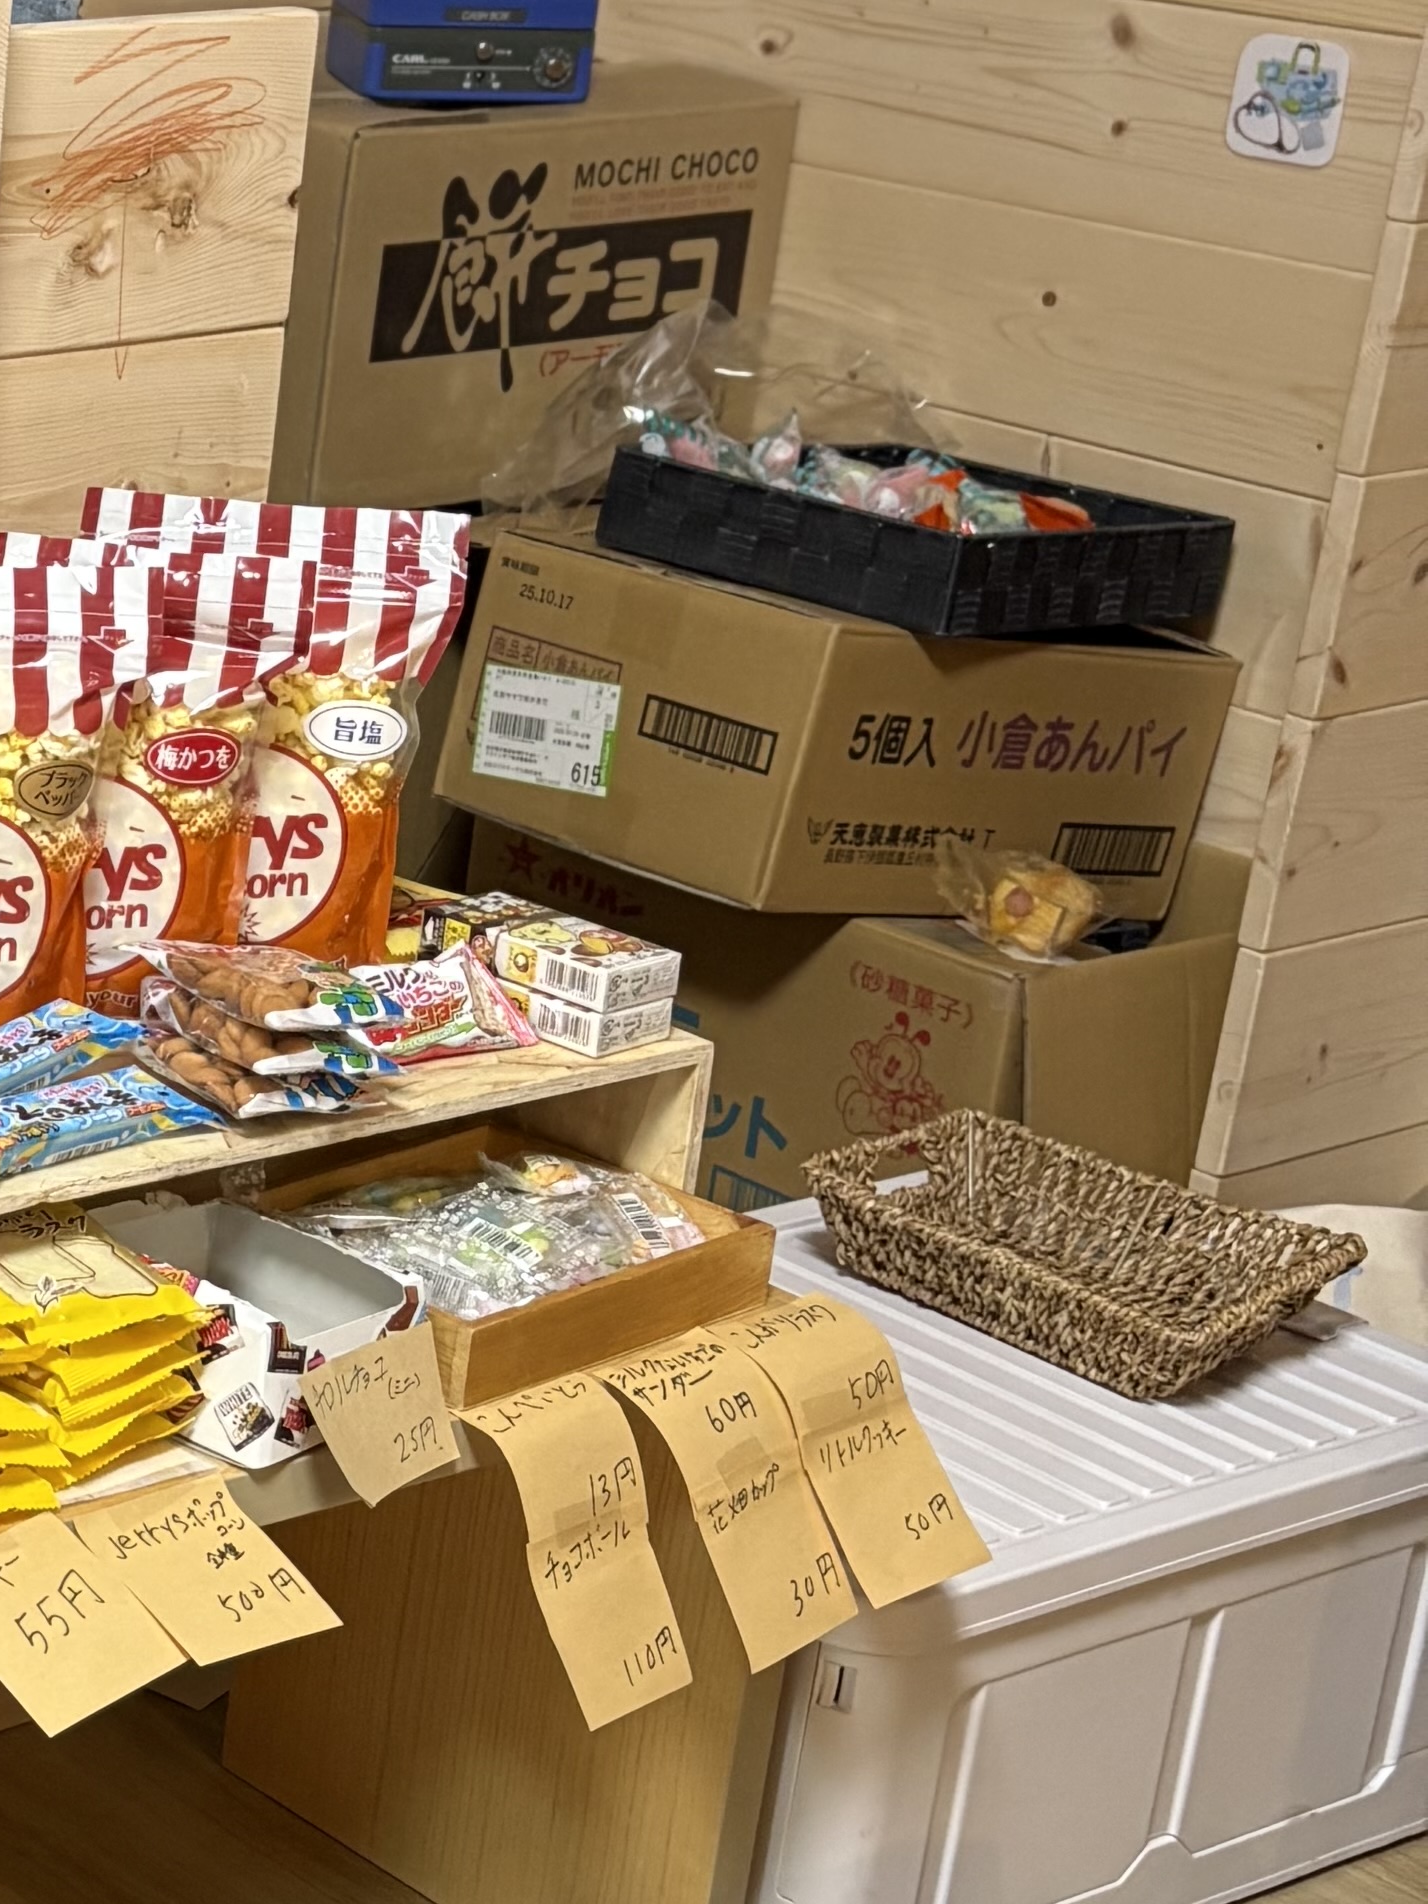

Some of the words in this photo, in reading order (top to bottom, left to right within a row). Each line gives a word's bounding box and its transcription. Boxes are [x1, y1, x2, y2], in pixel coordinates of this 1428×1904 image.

[574, 158, 660, 190] MOCHI
[671, 148, 758, 181] CHOCO
[519, 583, 574, 612] 25.10.17
[332, 715, 383, 746] 旨塩
[848, 713, 936, 769] 5個入
[956, 710, 1188, 778] 小倉あんパイ
[39, 769, 91, 789] ブラック
[155, 743, 234, 772] 梅かつを
[571, 761, 603, 787] 615
[632, 1369, 714, 1408] サンダー
[847, 1358, 895, 1410] 50円
[705, 1391, 758, 1434] 60円
[393, 1415, 439, 1464] 25円
[819, 1420, 908, 1474] リトルクッキー
[587, 1456, 638, 1517] 13円
[904, 1493, 955, 1541] 50円
[543, 1518, 631, 1590] チョコボール
[217, 1567, 306, 1623] 500円
[789, 1551, 842, 1618] 30円
[13, 1567, 105, 1655] 55円
[622, 1625, 678, 1687] 110円
